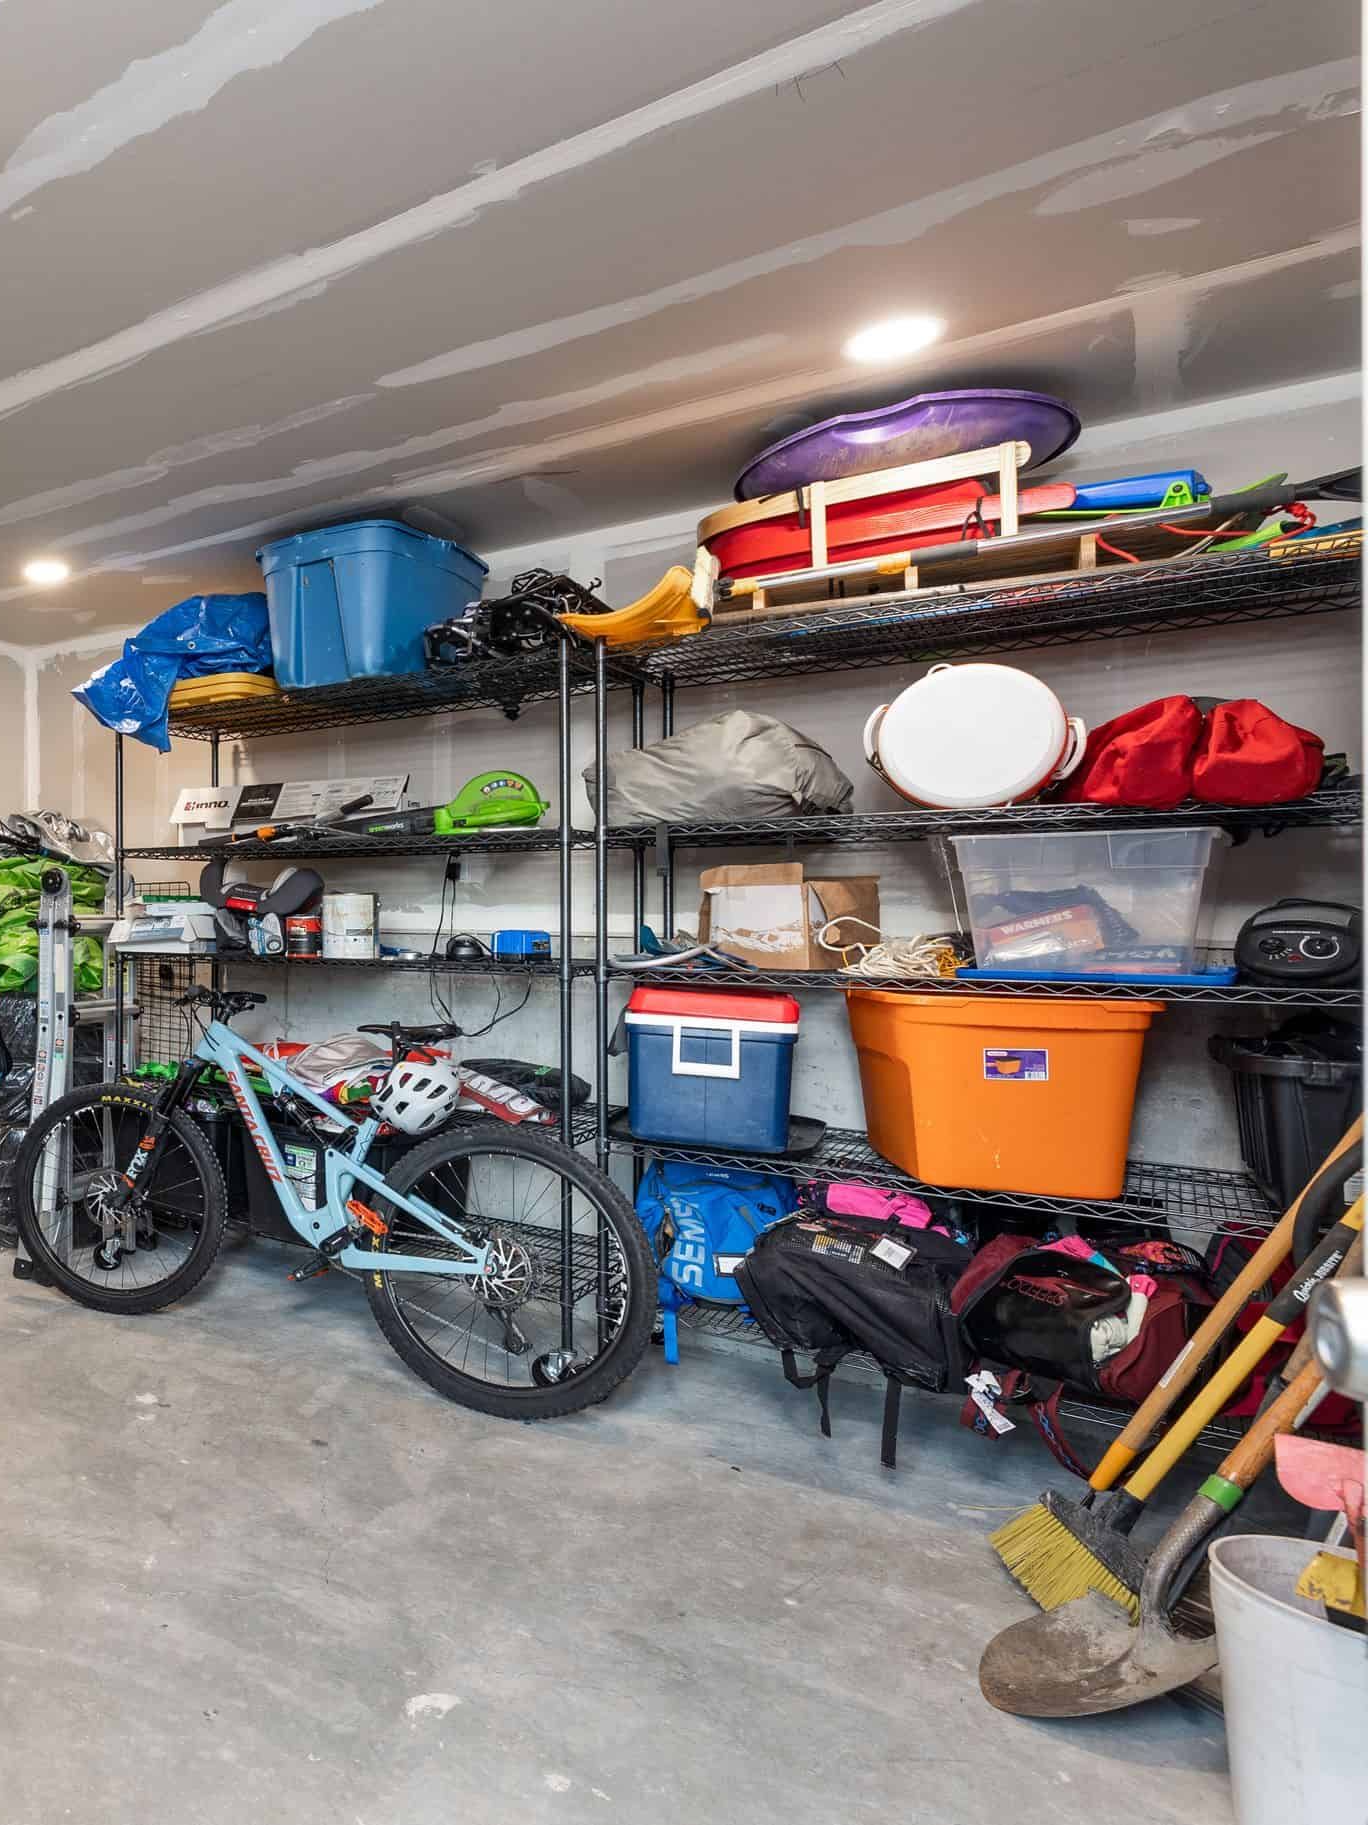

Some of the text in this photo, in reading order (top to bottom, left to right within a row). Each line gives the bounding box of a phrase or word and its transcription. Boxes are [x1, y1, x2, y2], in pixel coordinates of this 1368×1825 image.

[999, 910, 1074, 935] WARMERS
[101, 1095, 153, 1112] MAXXI
[226, 1071, 283, 1183] SANTA CRUZ
